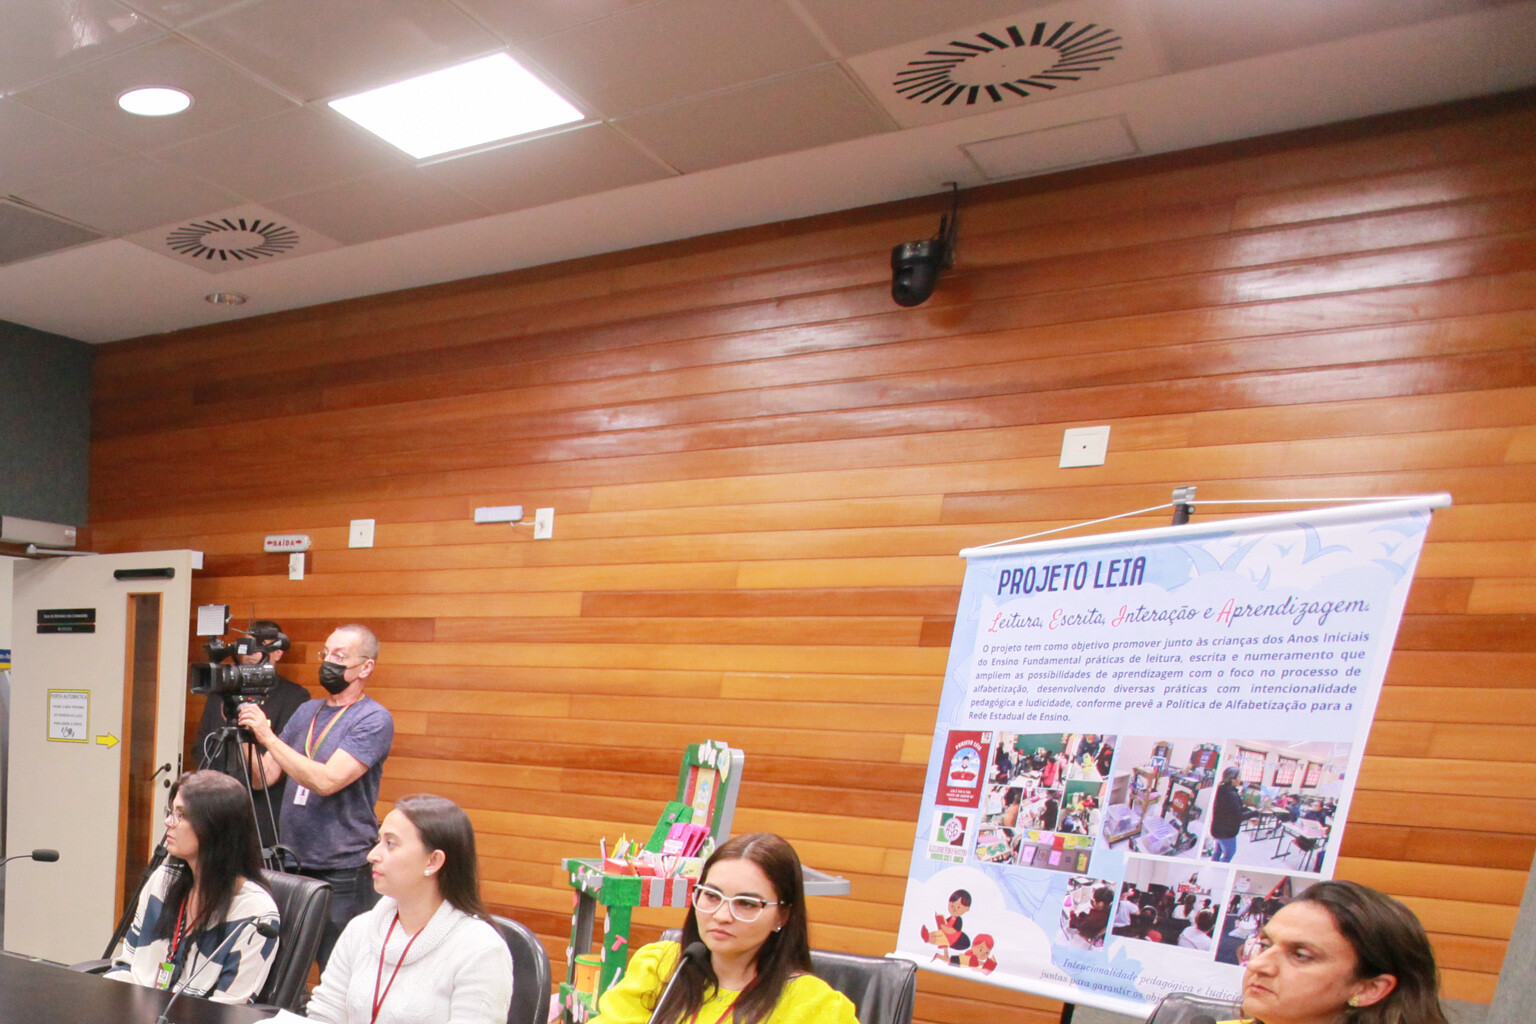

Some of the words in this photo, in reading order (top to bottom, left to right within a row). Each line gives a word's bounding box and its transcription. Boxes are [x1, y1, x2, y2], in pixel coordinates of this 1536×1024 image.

[998, 562, 1087, 595] PROJETO
[1094, 556, 1146, 588] LEIA
[988, 612, 1043, 632] Leitura,
[1049, 609, 1105, 630] Escrita,
[1112, 605, 1199, 626] Interação
[1204, 608, 1214, 618] e
[1216, 596, 1369, 627] Aprendizagem.
[992, 644, 1021, 654] projeto
[1072, 641, 1109, 652] objetivo
[1113, 641, 1160, 652] promover
[1163, 638, 1192, 648] junto
[1196, 637, 1208, 646] às
[1212, 636, 1258, 647] crianças
[1263, 635, 1283, 644] dos
[1287, 634, 1318, 643] Anos
[1324, 632, 1369, 642] Iniciais
[1023, 656, 1081, 665] Fundamental
[1085, 655, 1124, 666] práticas
[1129, 655, 1140, 663] de
[1146, 654, 1183, 664] leitura,
[1244, 651, 1333, 660] numeramento
[1341, 651, 1365, 661] que
[976, 671, 1010, 680] ampliem
[1028, 670, 1091, 680] possibilidades
[1096, 670, 1107, 678] de
[1112, 669, 1183, 680] aprendizagem
[1230, 668, 1254, 677] foco
[1260, 669, 1275, 677] no
[1281, 668, 1338, 679] processo
[1346, 666, 1361, 676] de
[973, 685, 1029, 695] alfabetização,
[1037, 685, 1105, 693] desenvolvendo
[1114, 685, 1155, 693] diversas
[1164, 684, 1207, 695] práticas
[1217, 685, 1240, 693] com
[1251, 683, 1357, 693] intencionalidade
[971, 698, 1015, 708] pedagógica
[1026, 698, 1073, 708] ludicidade,
[1077, 699, 1121, 708] conforme
[1125, 699, 1153, 710] prevê
[1166, 700, 1205, 709] Política
[1209, 700, 1222, 709] de
[1225, 700, 1306, 712] Alfabetização
[1310, 702, 1340, 713] para
[1345, 703, 1352, 711] a
[990, 712, 1024, 720] Estadual
[1027, 712, 1037, 720] de
[1040, 713, 1071, 721] Ensino.
[1040, 970, 1068, 982] juntas
[1070, 977, 1090, 989] para
[1092, 982, 1131, 997] garantir
[1133, 990, 1143, 998] os
[1063, 958, 1138, 981] Intencionalidade
[1138, 976, 1194, 993] pedagógica
